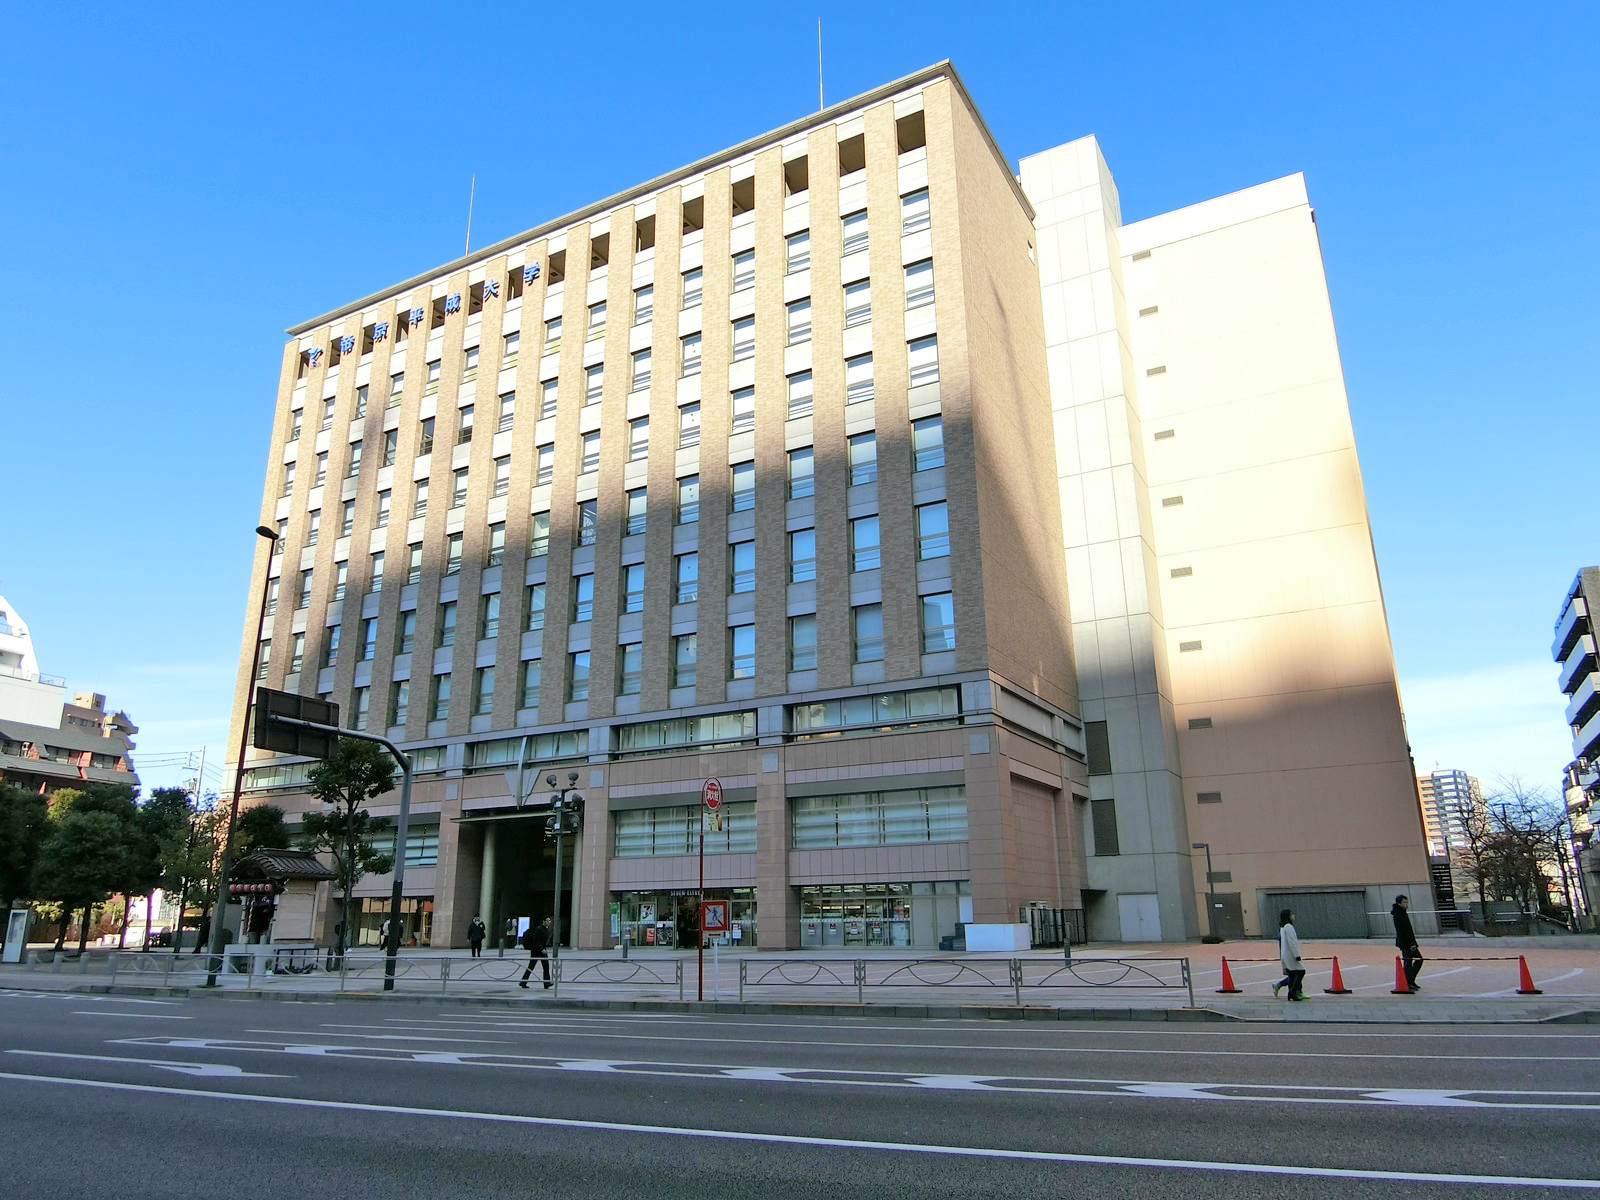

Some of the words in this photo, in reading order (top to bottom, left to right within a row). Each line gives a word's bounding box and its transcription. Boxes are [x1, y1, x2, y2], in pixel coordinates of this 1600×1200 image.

[340, 262, 540, 352] 帝京平成大学
